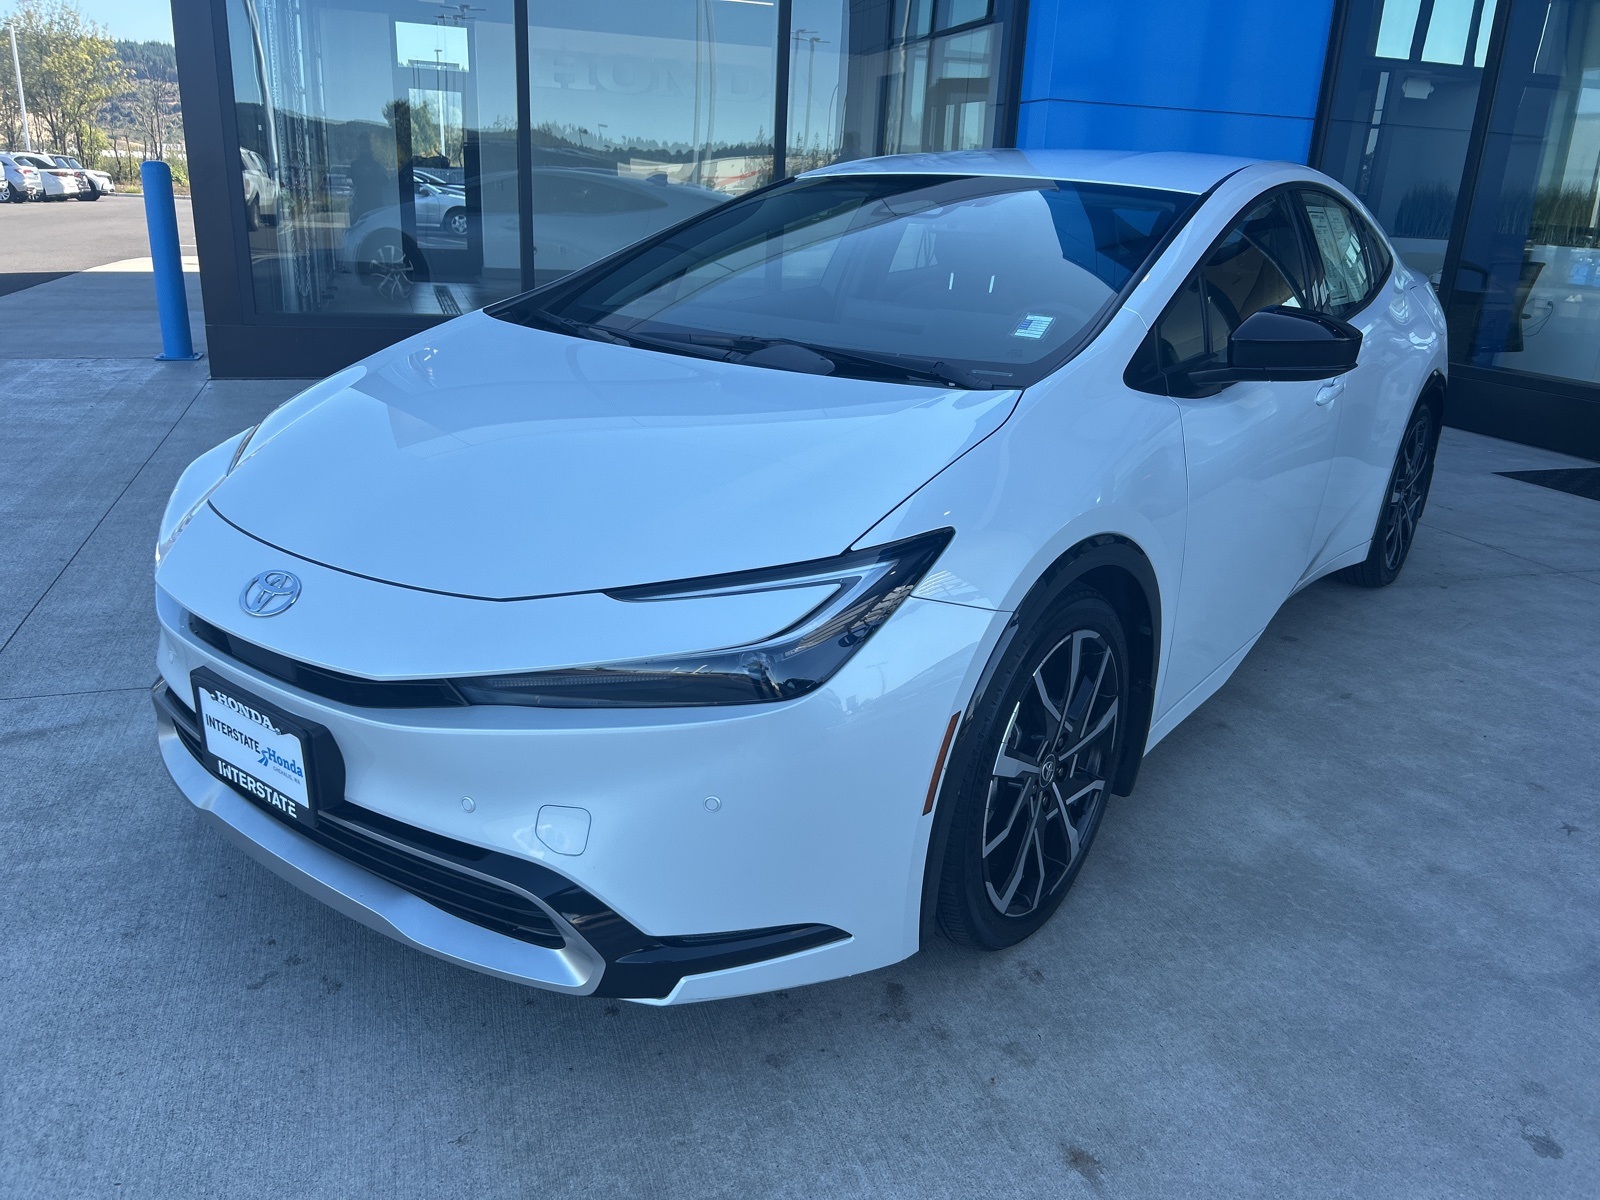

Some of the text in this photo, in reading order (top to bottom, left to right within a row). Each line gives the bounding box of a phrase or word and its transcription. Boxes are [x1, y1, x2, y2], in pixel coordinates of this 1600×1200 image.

[214, 690, 276, 732] HONDA
[206, 714, 261, 754] INTERSTATE
[266, 747, 304, 778] Honda
[218, 760, 298, 818] INTERSTATE
